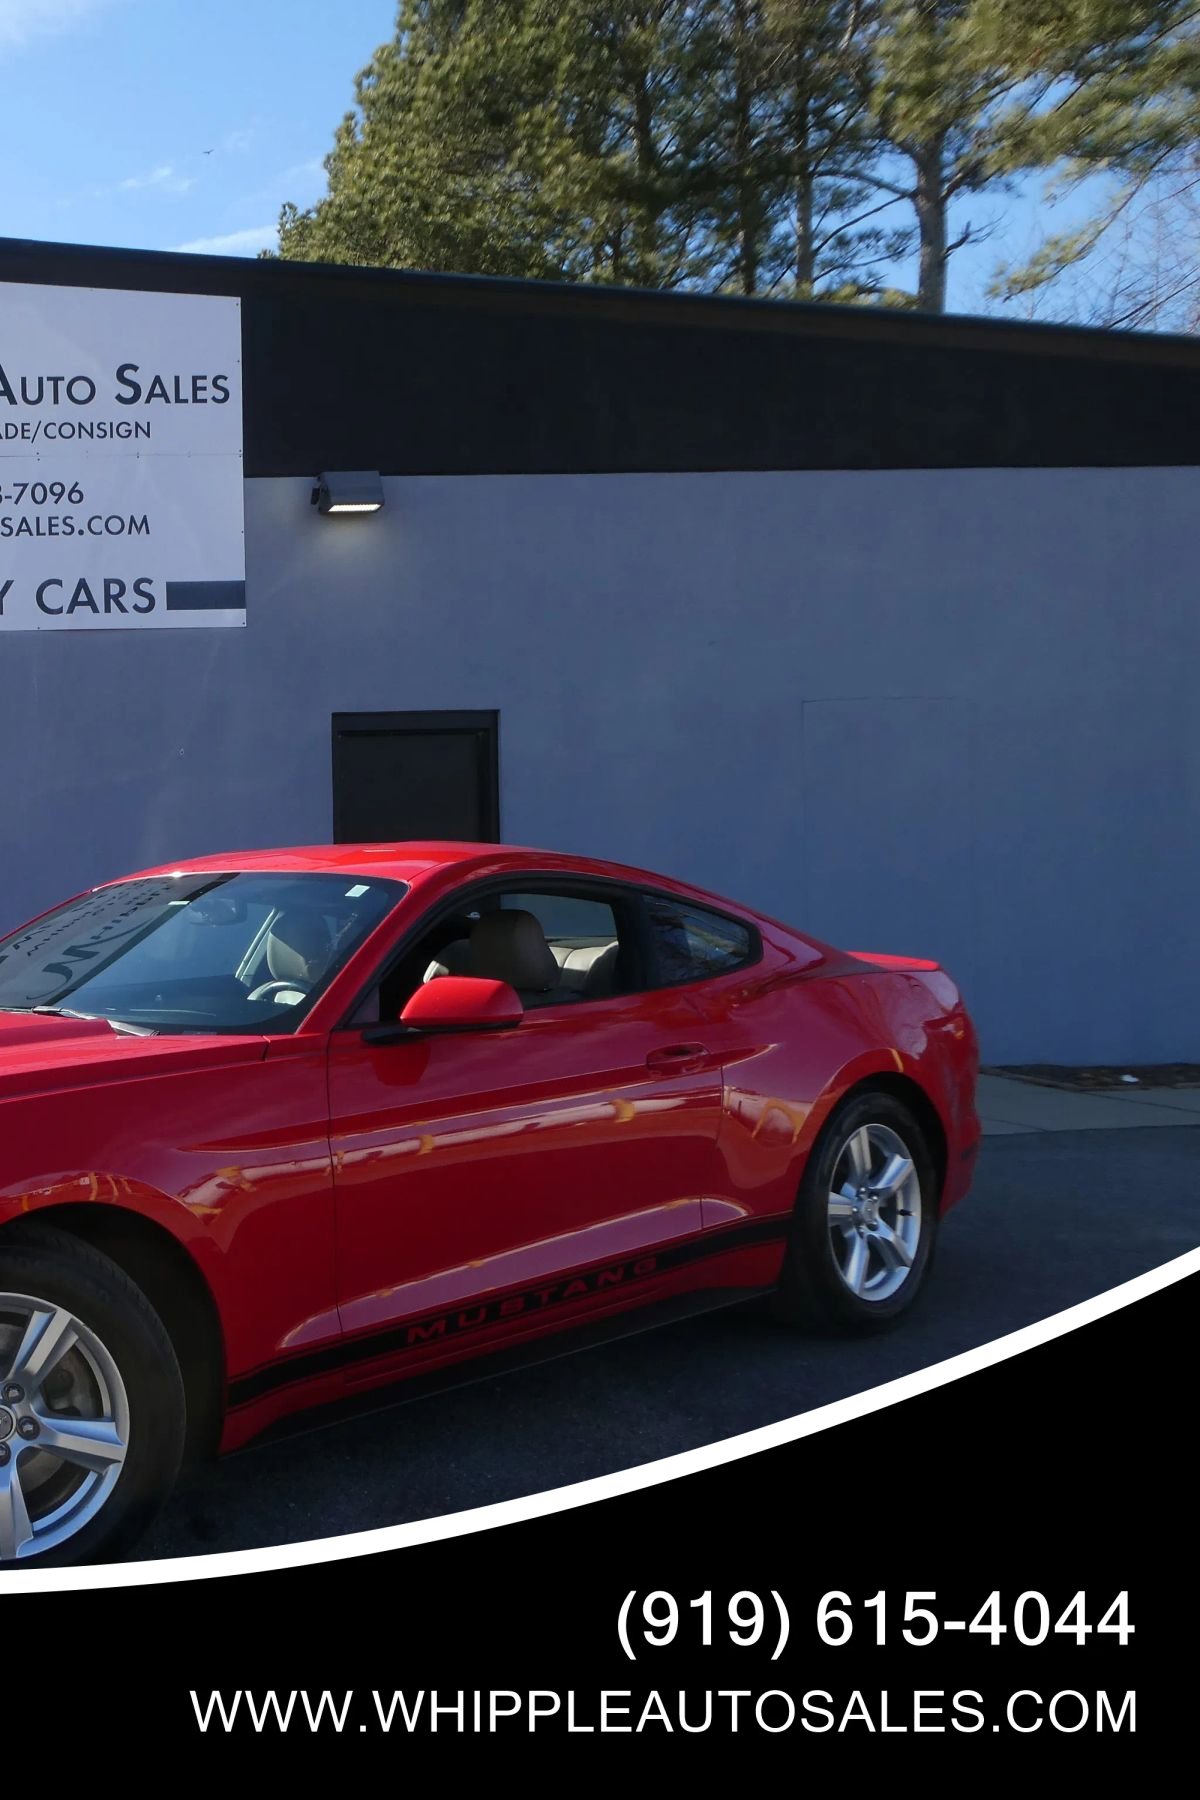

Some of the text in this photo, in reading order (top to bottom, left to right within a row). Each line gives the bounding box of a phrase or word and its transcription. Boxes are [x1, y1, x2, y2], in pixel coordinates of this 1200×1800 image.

[114, 363, 230, 406] SALES
[35, 577, 156, 616] CARS
[405, 1257, 658, 1345] MUSTANG
